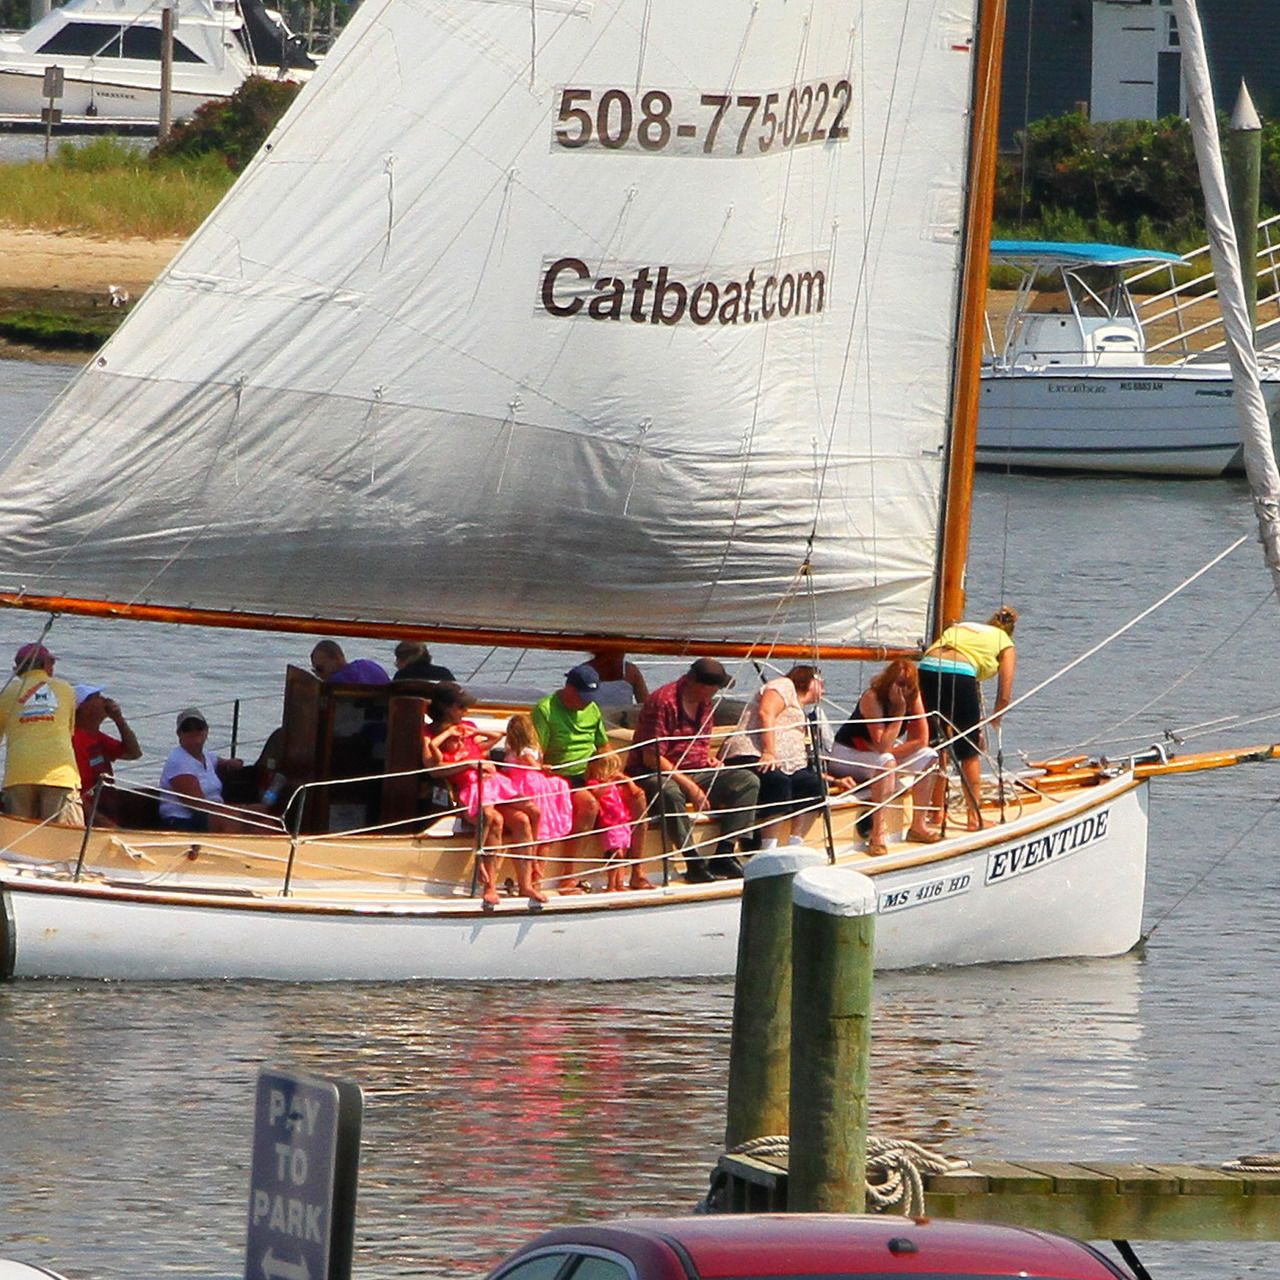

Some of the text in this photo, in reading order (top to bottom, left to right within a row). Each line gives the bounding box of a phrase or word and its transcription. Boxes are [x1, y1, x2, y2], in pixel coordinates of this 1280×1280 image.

[554, 79, 853, 154] 508-775-0222
[541, 256, 826, 326] Catboat.com
[988, 809, 1111, 880] EVENTIDE
[883, 889, 910, 909] MS
[948, 875, 971, 893] HD
[275, 1142, 308, 1187] TO
[252, 1188, 322, 1245] PARK
